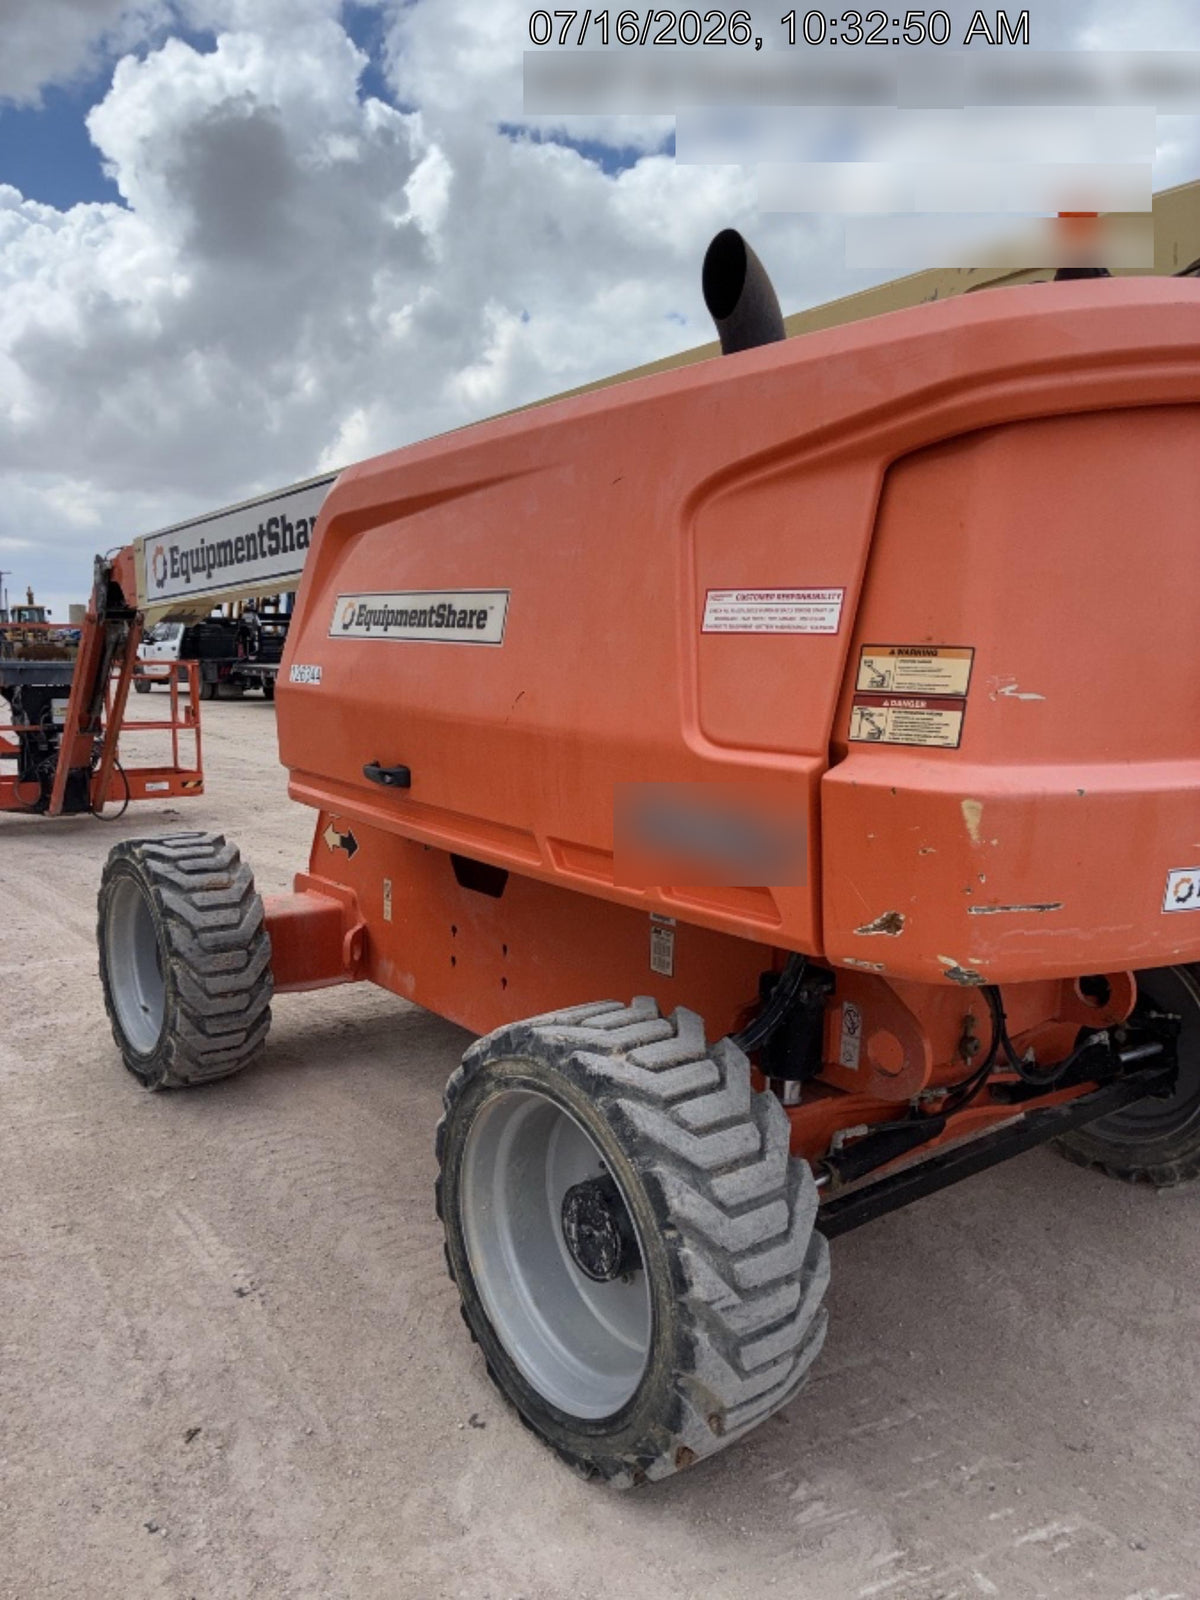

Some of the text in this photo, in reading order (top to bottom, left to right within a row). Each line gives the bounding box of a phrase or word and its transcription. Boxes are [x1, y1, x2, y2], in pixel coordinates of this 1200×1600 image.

[355, 603, 488, 632] EquipmentShare
[897, 648, 938, 657] WARNING
[890, 699, 928, 708] DANGER
